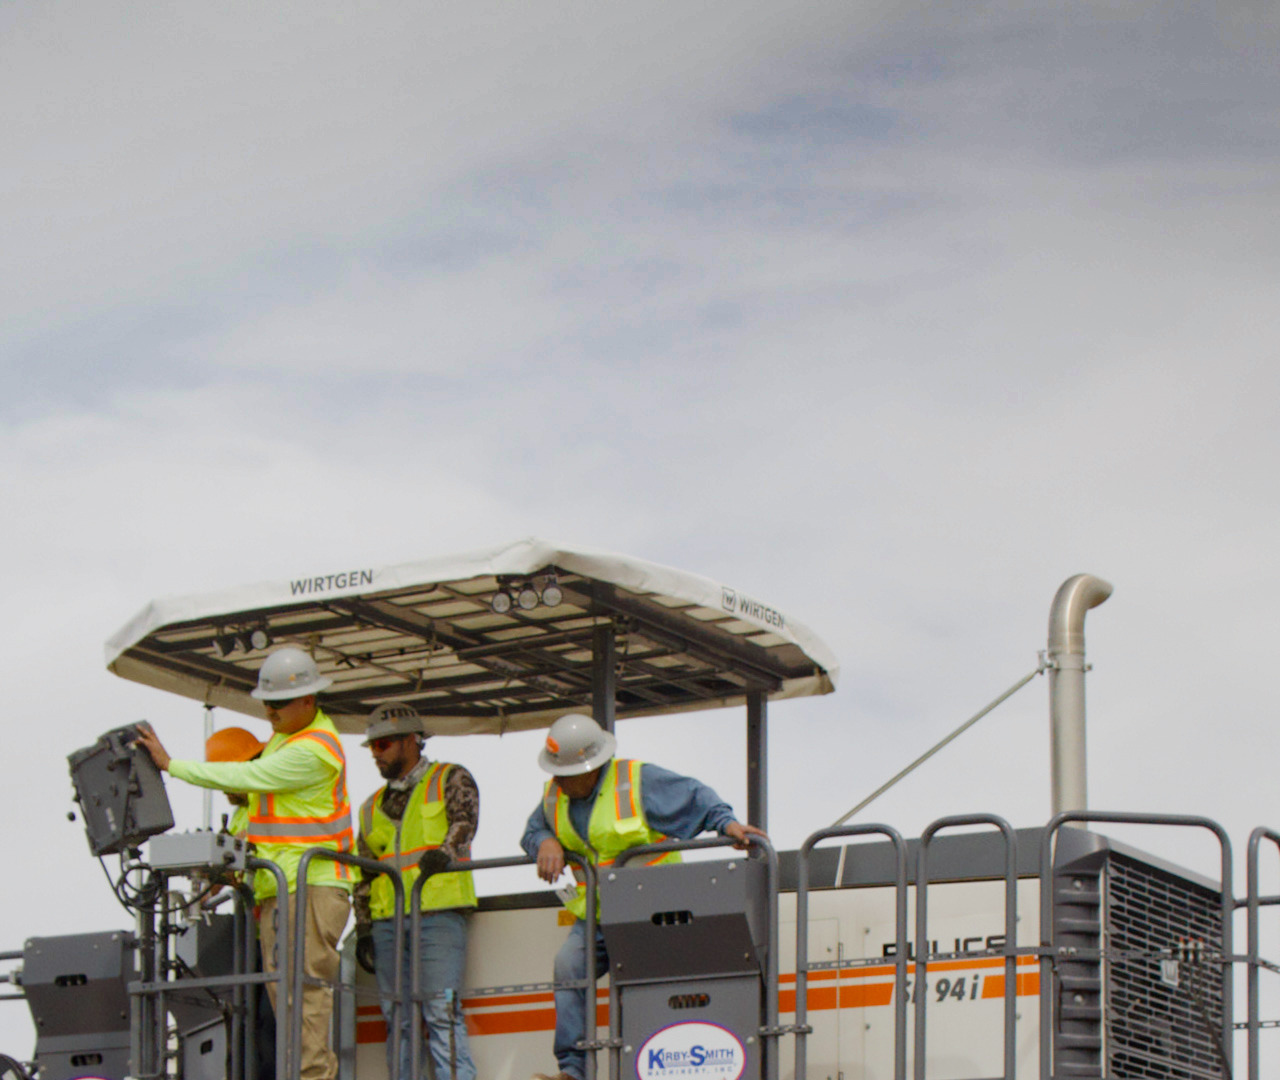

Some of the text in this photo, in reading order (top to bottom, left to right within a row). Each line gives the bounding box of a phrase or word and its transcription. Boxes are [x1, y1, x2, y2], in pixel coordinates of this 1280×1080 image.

[290, 568, 373, 596] WIRTGEN
[740, 597, 786, 630] WIRTGEN
[648, 1045, 734, 1069] KIRBY-SMITH
